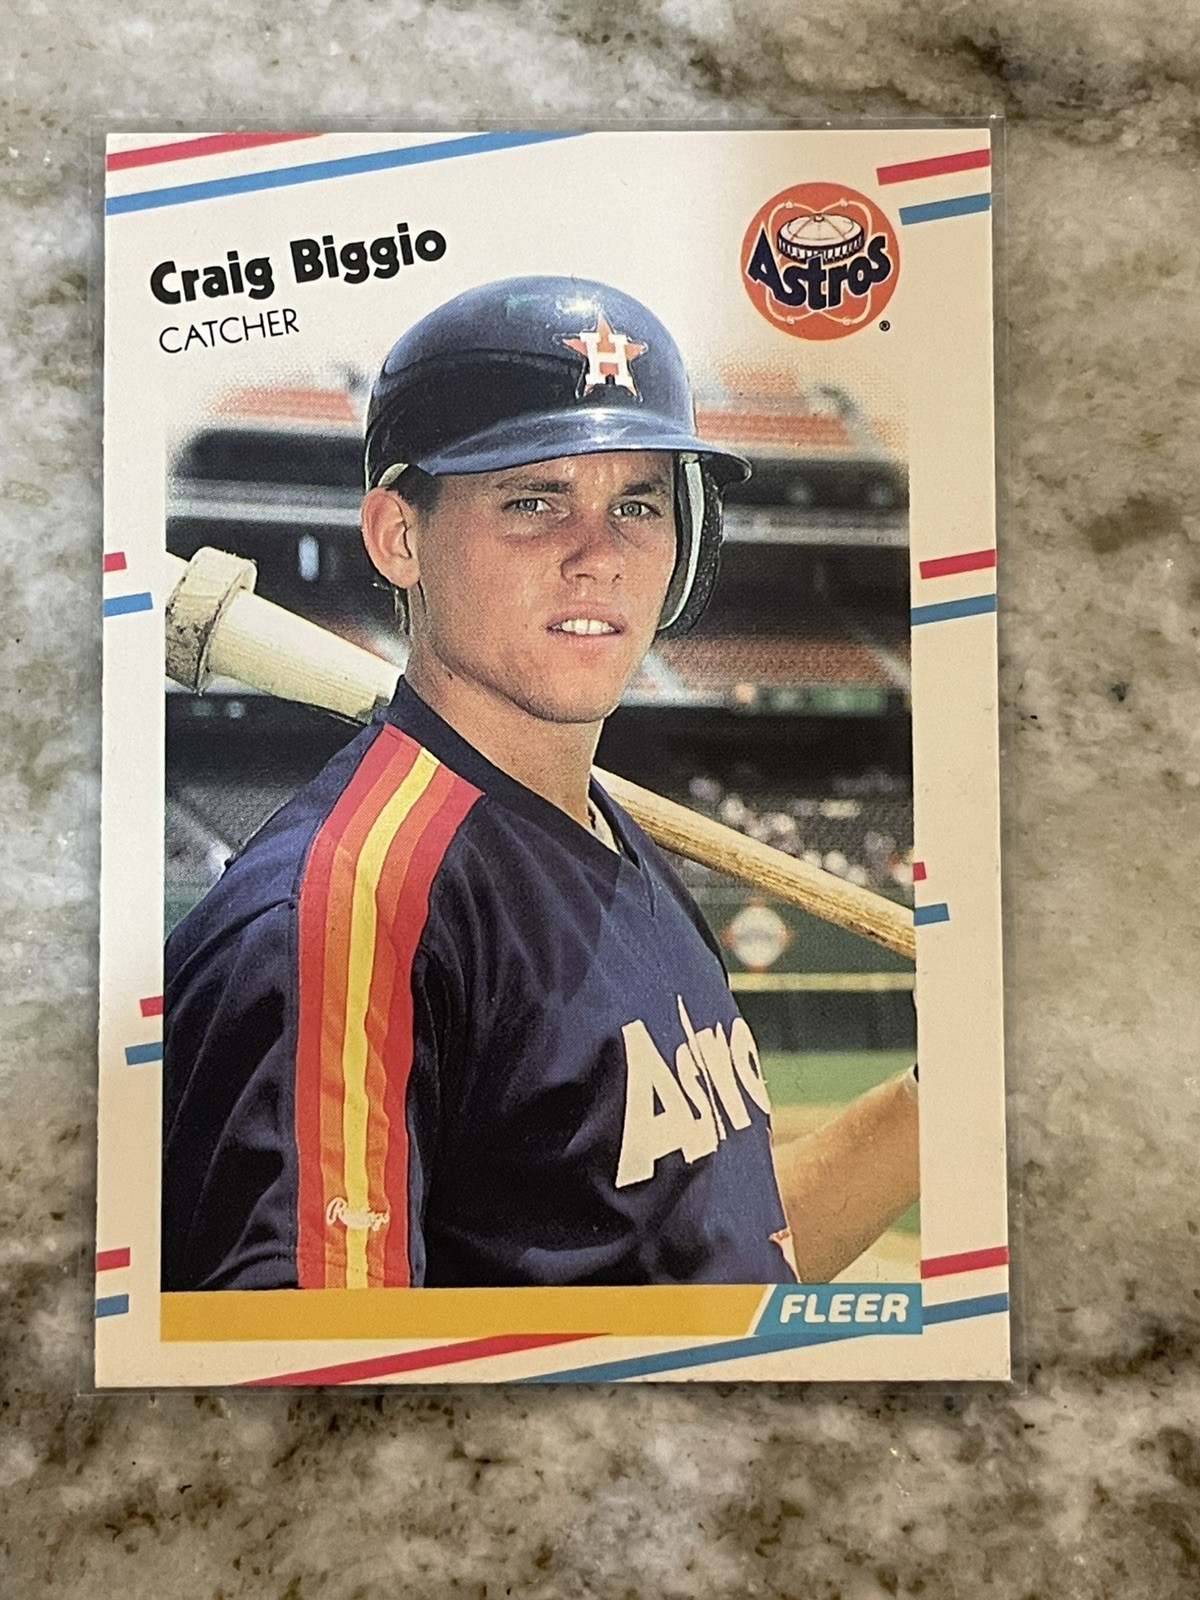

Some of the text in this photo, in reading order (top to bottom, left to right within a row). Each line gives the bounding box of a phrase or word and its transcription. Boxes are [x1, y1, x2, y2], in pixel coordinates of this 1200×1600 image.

[150, 222, 447, 305] Craig Biggio
[747, 222, 892, 311] Astros
[158, 308, 300, 354] CATCHER
[578, 331, 634, 386] H
[779, 1293, 910, 1324] FLEER
